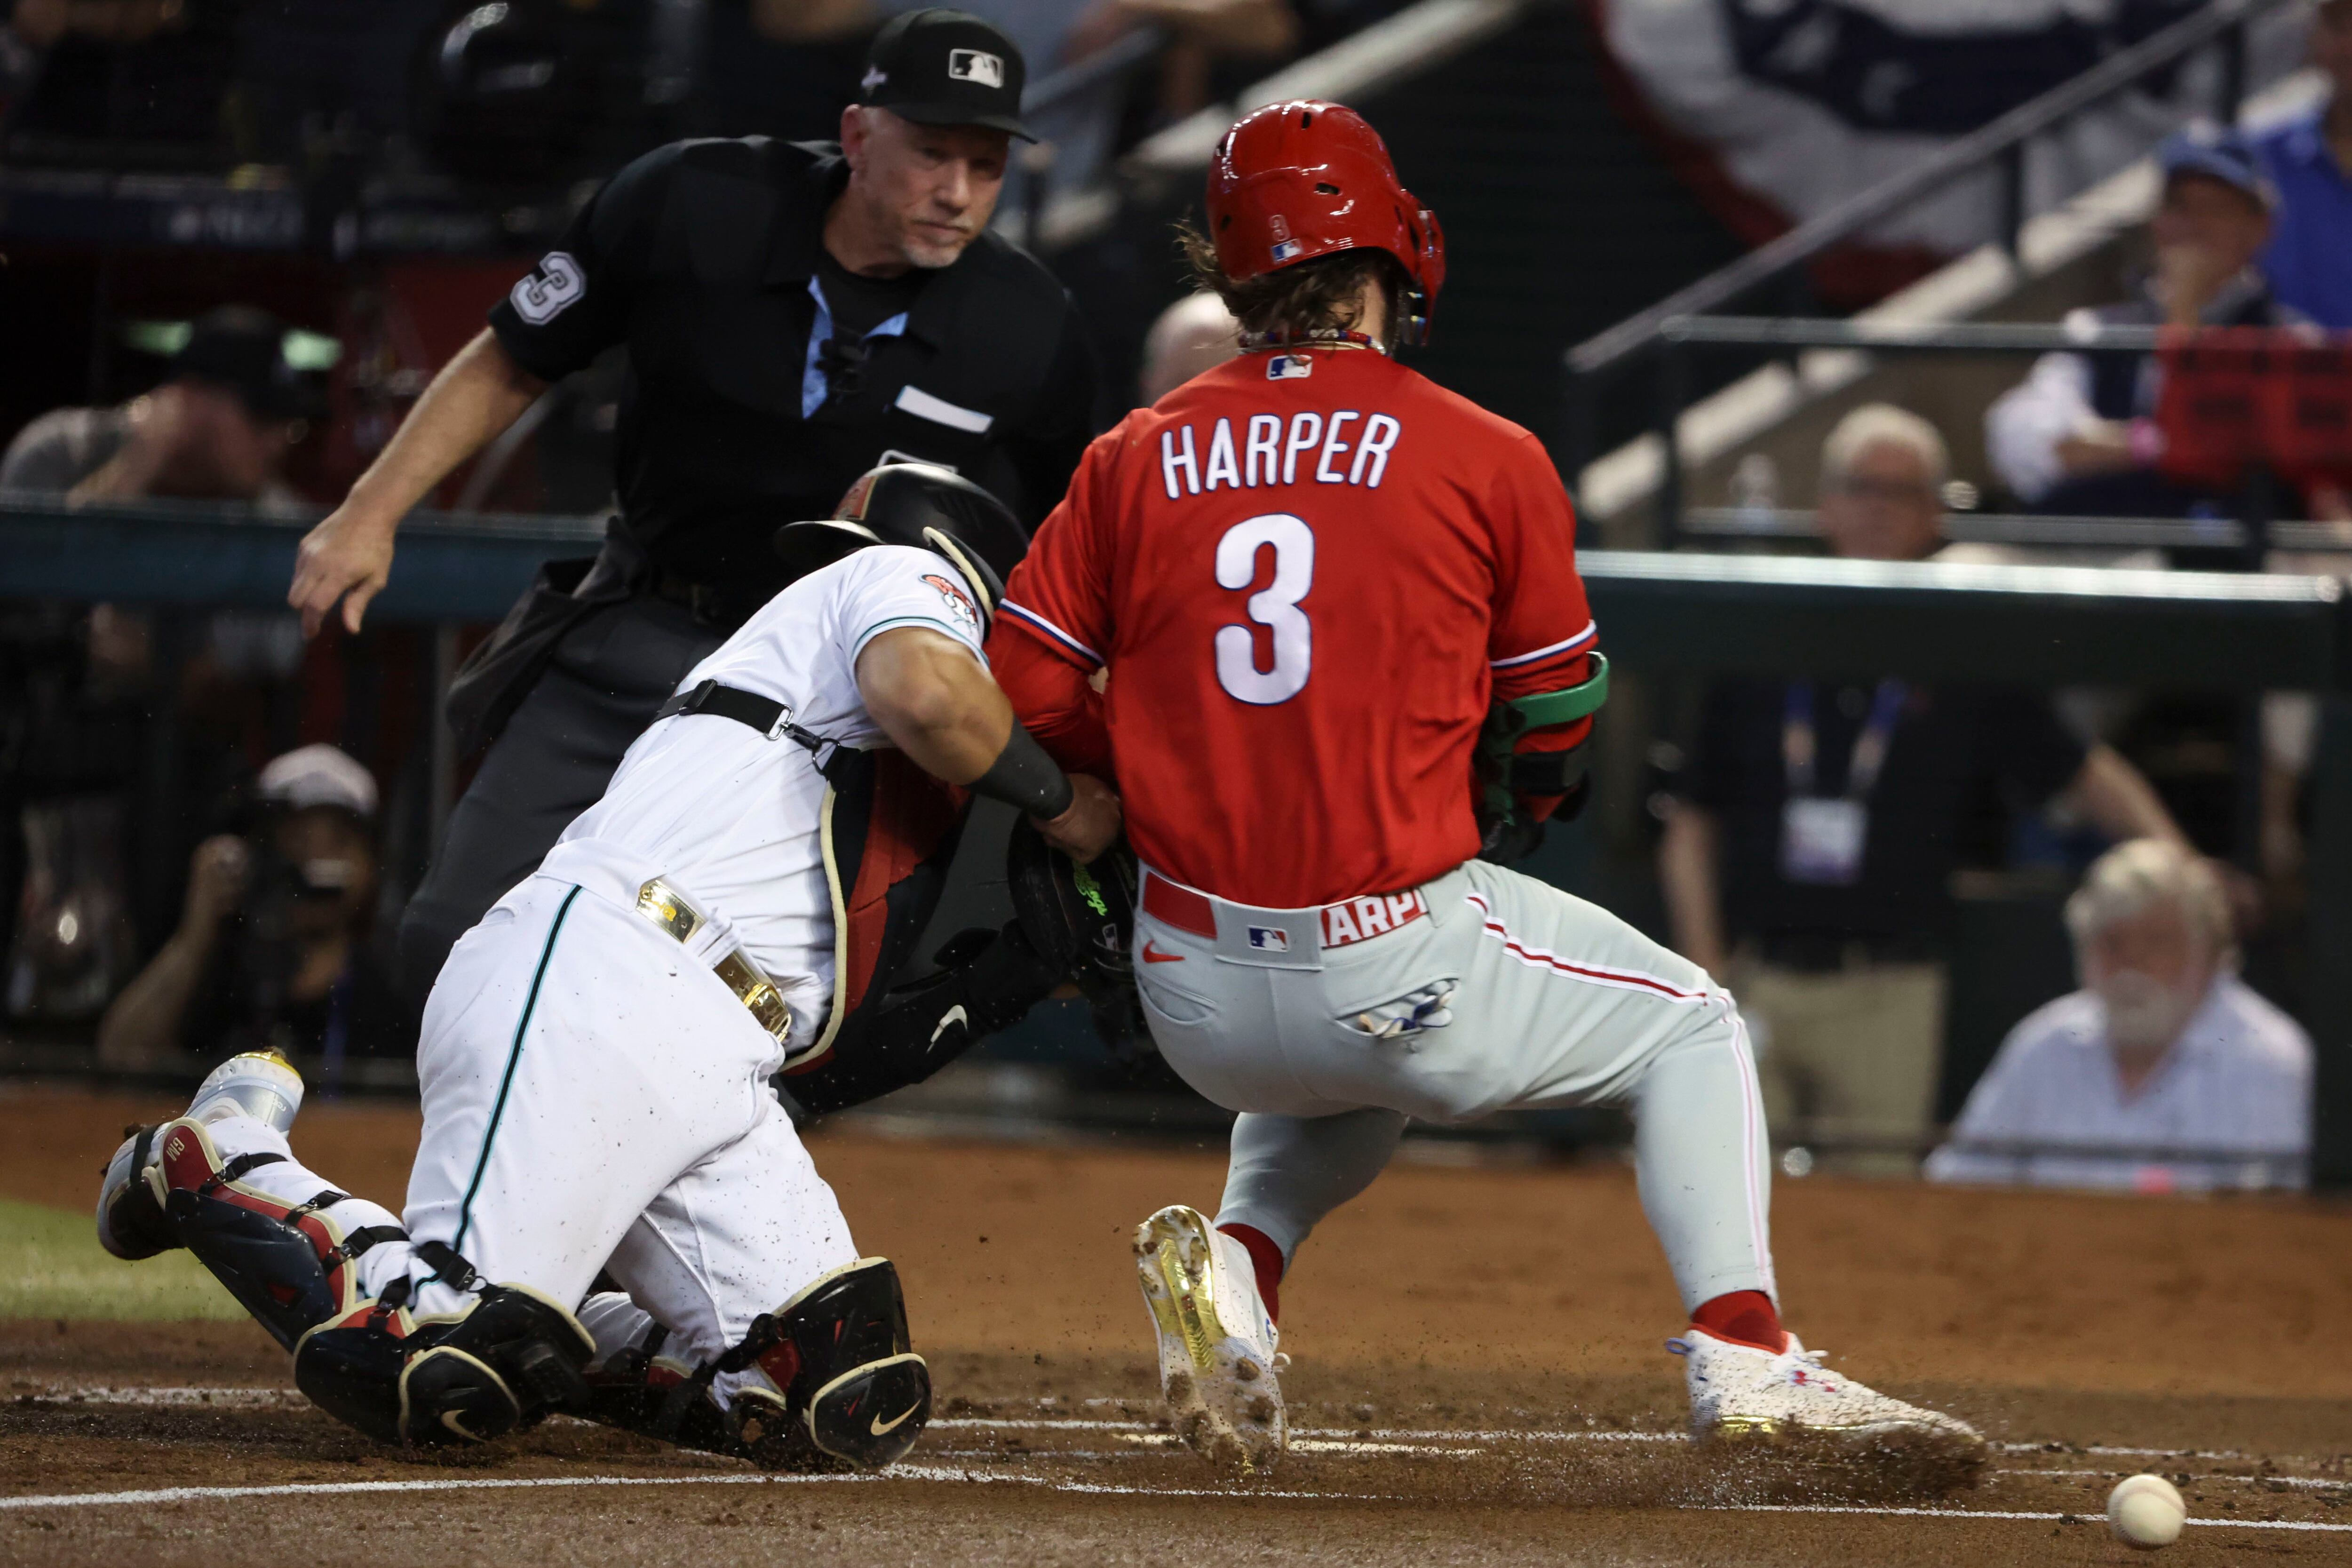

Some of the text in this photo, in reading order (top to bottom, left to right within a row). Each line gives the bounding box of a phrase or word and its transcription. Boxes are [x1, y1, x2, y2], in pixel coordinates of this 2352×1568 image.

[509, 251, 586, 326] 3
[1161, 409, 1401, 500] HARPER
[1214, 511, 1315, 706] 3
[1319, 888, 1428, 947] ARP
[166, 1137, 184, 1162] GM
